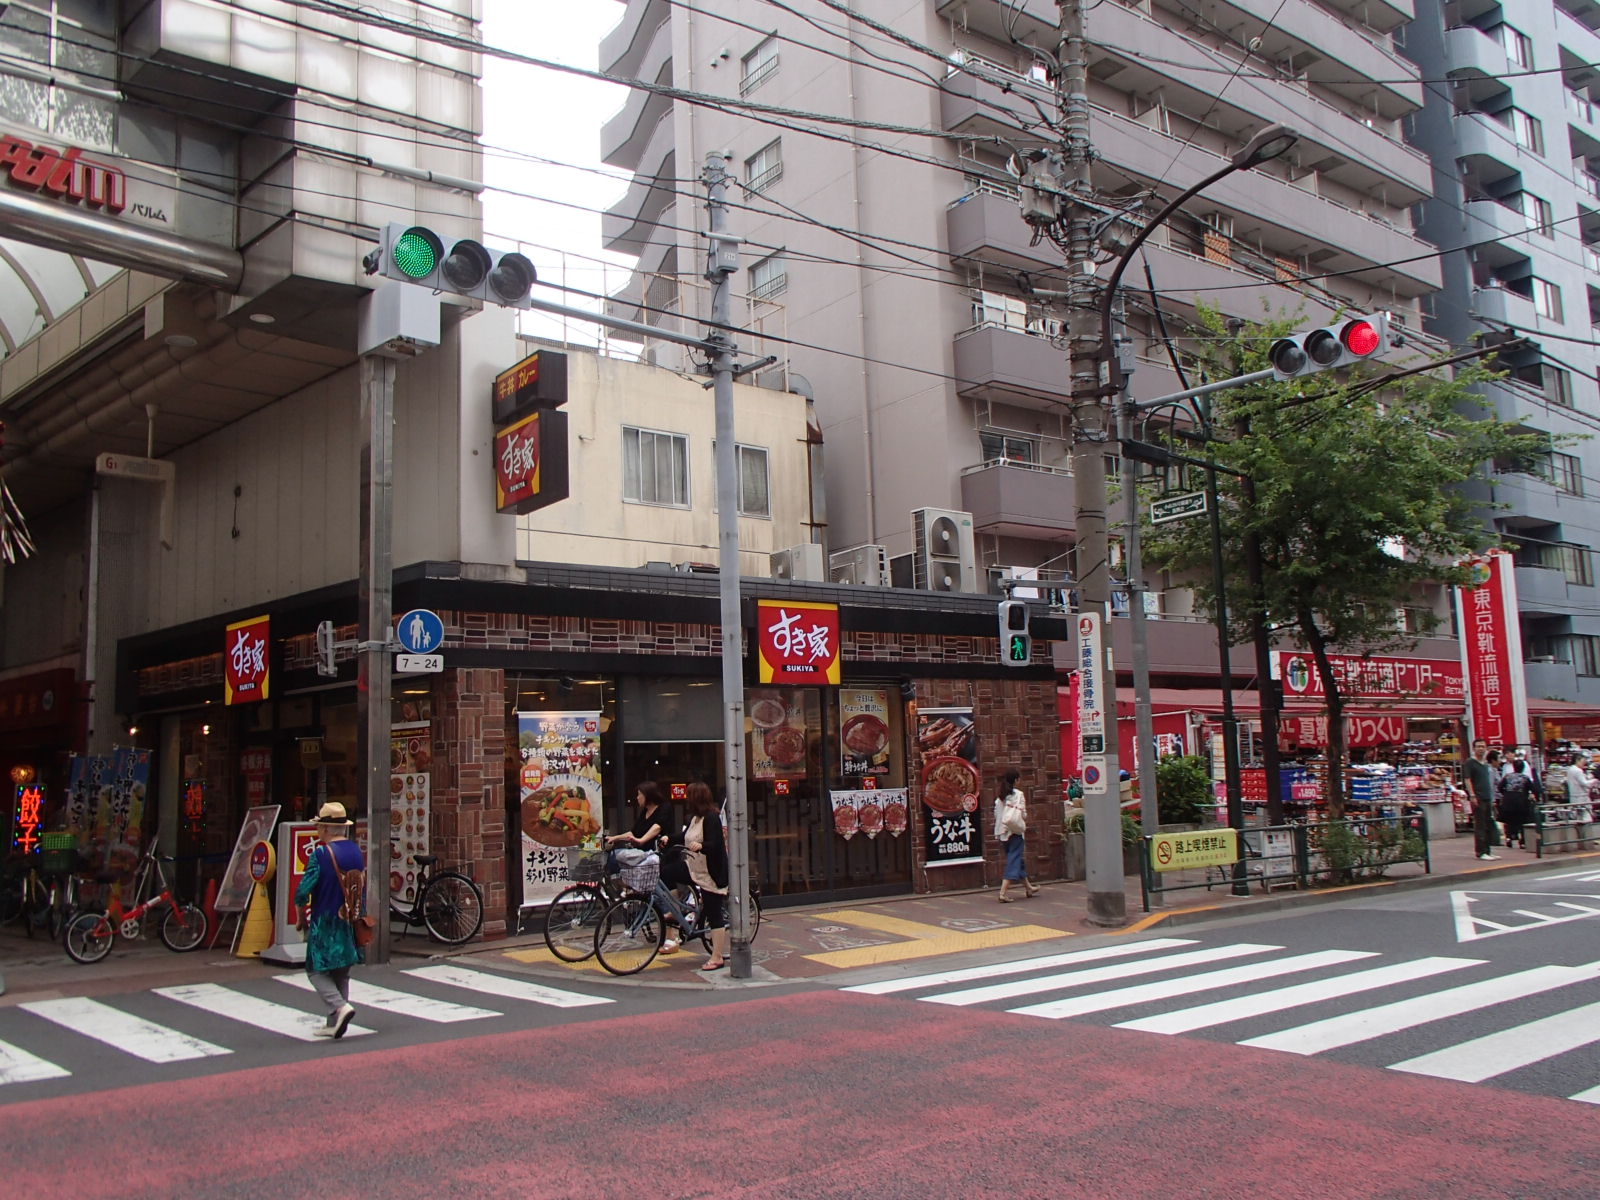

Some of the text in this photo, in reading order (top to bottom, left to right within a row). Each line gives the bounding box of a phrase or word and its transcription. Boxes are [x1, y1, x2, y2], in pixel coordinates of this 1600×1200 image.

[502, 434, 534, 480] すき家
[769, 608, 831, 664] すき家
[231, 629, 265, 681] すき家
[18, 788, 41, 854] 餃子
[931, 816, 976, 844] うな牛
[526, 851, 565, 868] チキンと
[1175, 835, 1227, 854] 路上喫煙禁止
[526, 866, 571, 885] 彩り野菜
